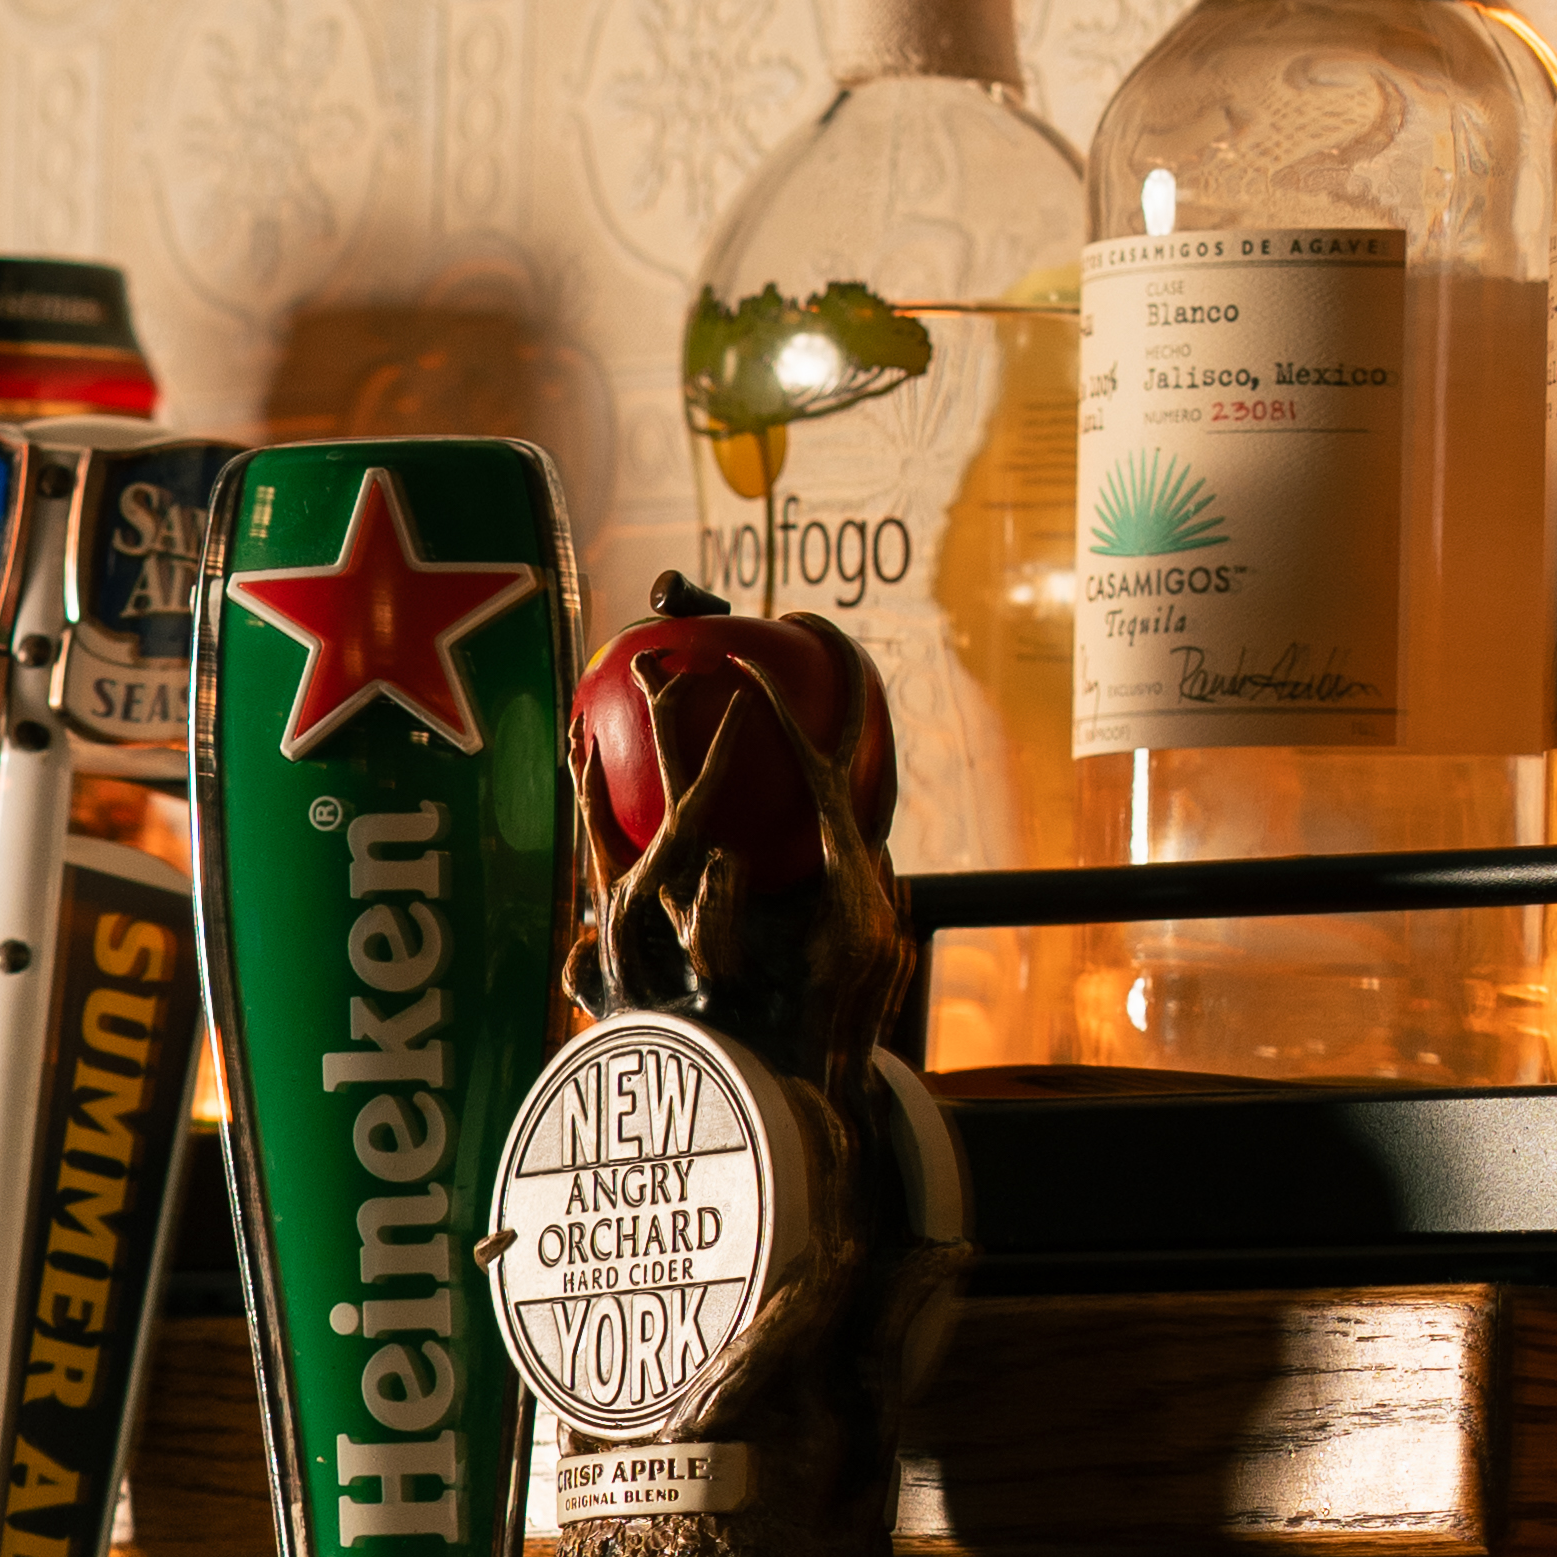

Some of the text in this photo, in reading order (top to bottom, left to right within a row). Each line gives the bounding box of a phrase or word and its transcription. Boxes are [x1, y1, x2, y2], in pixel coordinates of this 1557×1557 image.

[1108, 241, 1224, 264] CASAMIGOS
[1241, 239, 1270, 255] DE
[1290, 238, 1378, 255] AGAVE
[1146, 302, 1240, 327] Blanco
[1143, 361, 1387, 391] Jalisco, Mexico
[1210, 400, 1297, 422] 23081
[1086, 565, 1231, 602] CASAMIGOS
[1105, 604, 1187, 646] Tequila
[561, 1049, 703, 1169] NEW
[22, 910, 177, 1413] SUMMER
[322, 798, 468, 1549] Heineken
[565, 1158, 695, 1215] ANGRY
[537, 1207, 723, 1269] ORCHARD
[562, 1258, 695, 1293] HARD CIDER
[551, 1285, 709, 1408] YORK
[557, 1457, 713, 1494] CRISP APPLE
[564, 1487, 680, 1512] ORIGINAL BLEND
